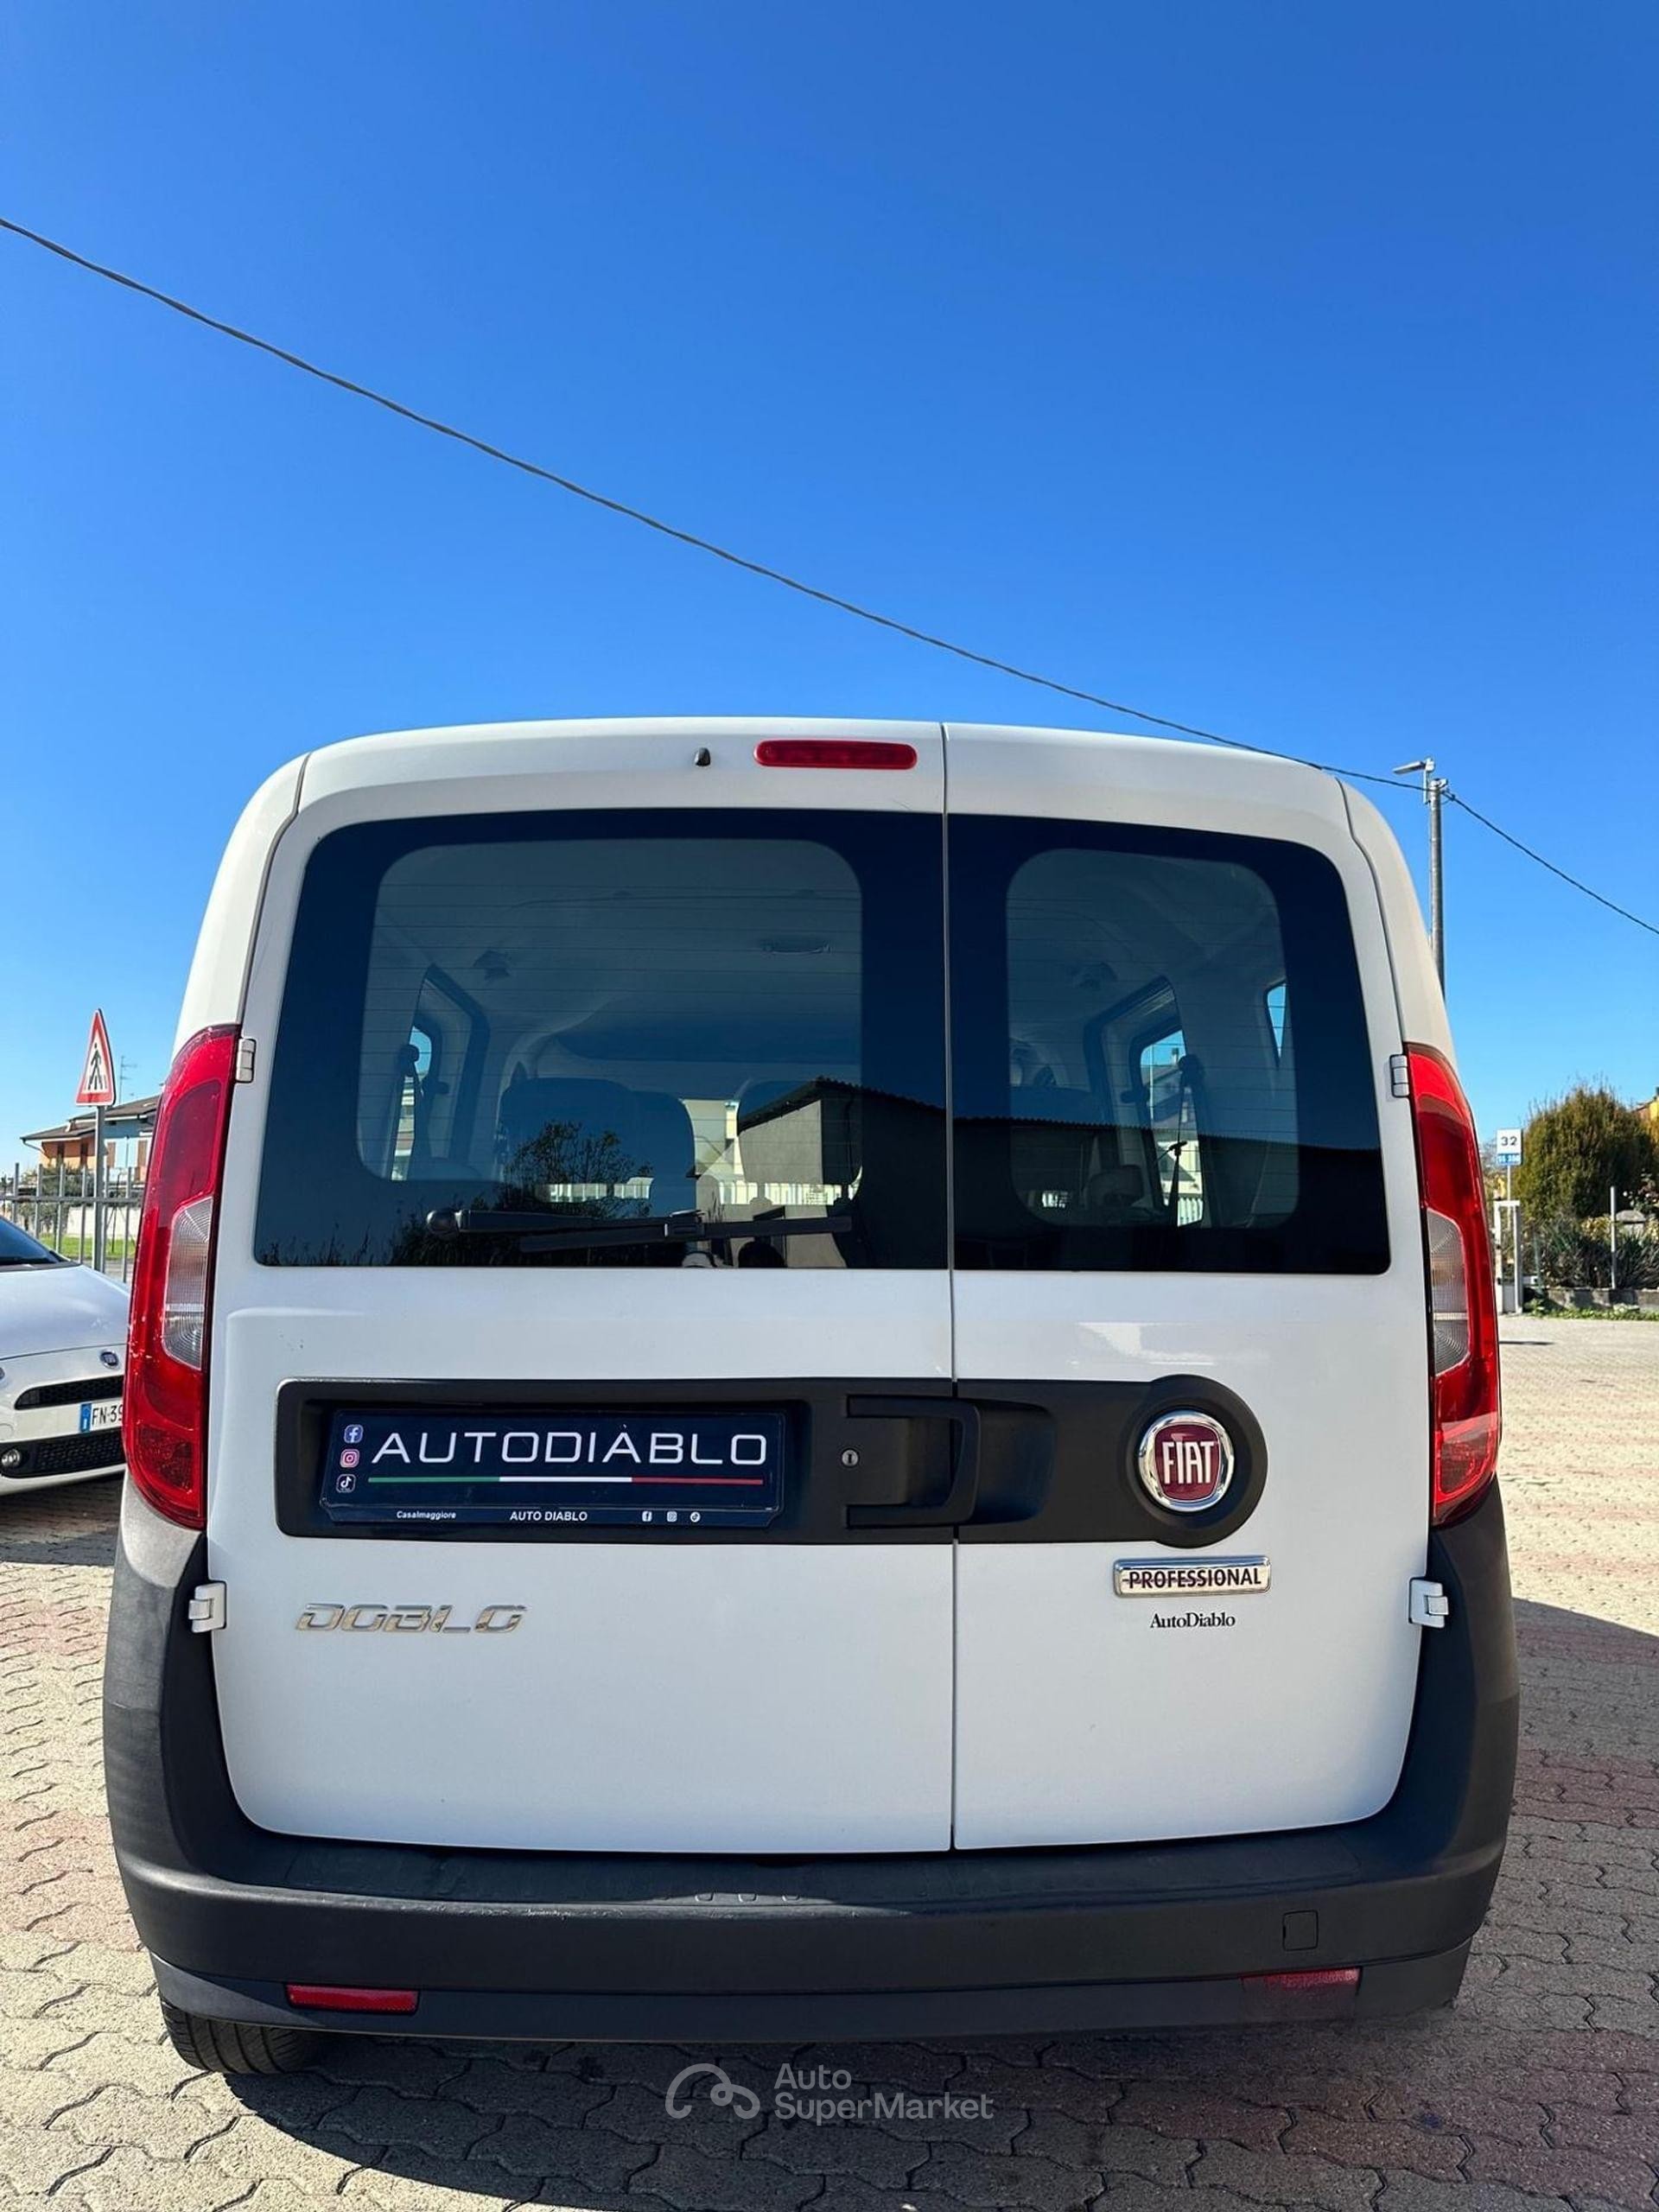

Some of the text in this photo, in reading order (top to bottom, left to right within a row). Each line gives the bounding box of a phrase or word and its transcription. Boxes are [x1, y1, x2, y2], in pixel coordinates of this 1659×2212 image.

[1501, 1135, 1518, 1147] 32
[372, 1431, 767, 1465] AUTODIABLO
[1161, 1440, 1215, 1484] FIAT
[396, 1510, 457, 1521] Casalmaggiore
[510, 1511, 588, 1522] AUTO DIABLO
[1128, 1567, 1262, 1589] PROFESSIONAL
[1149, 1611, 1236, 1629] AutoDiablo
